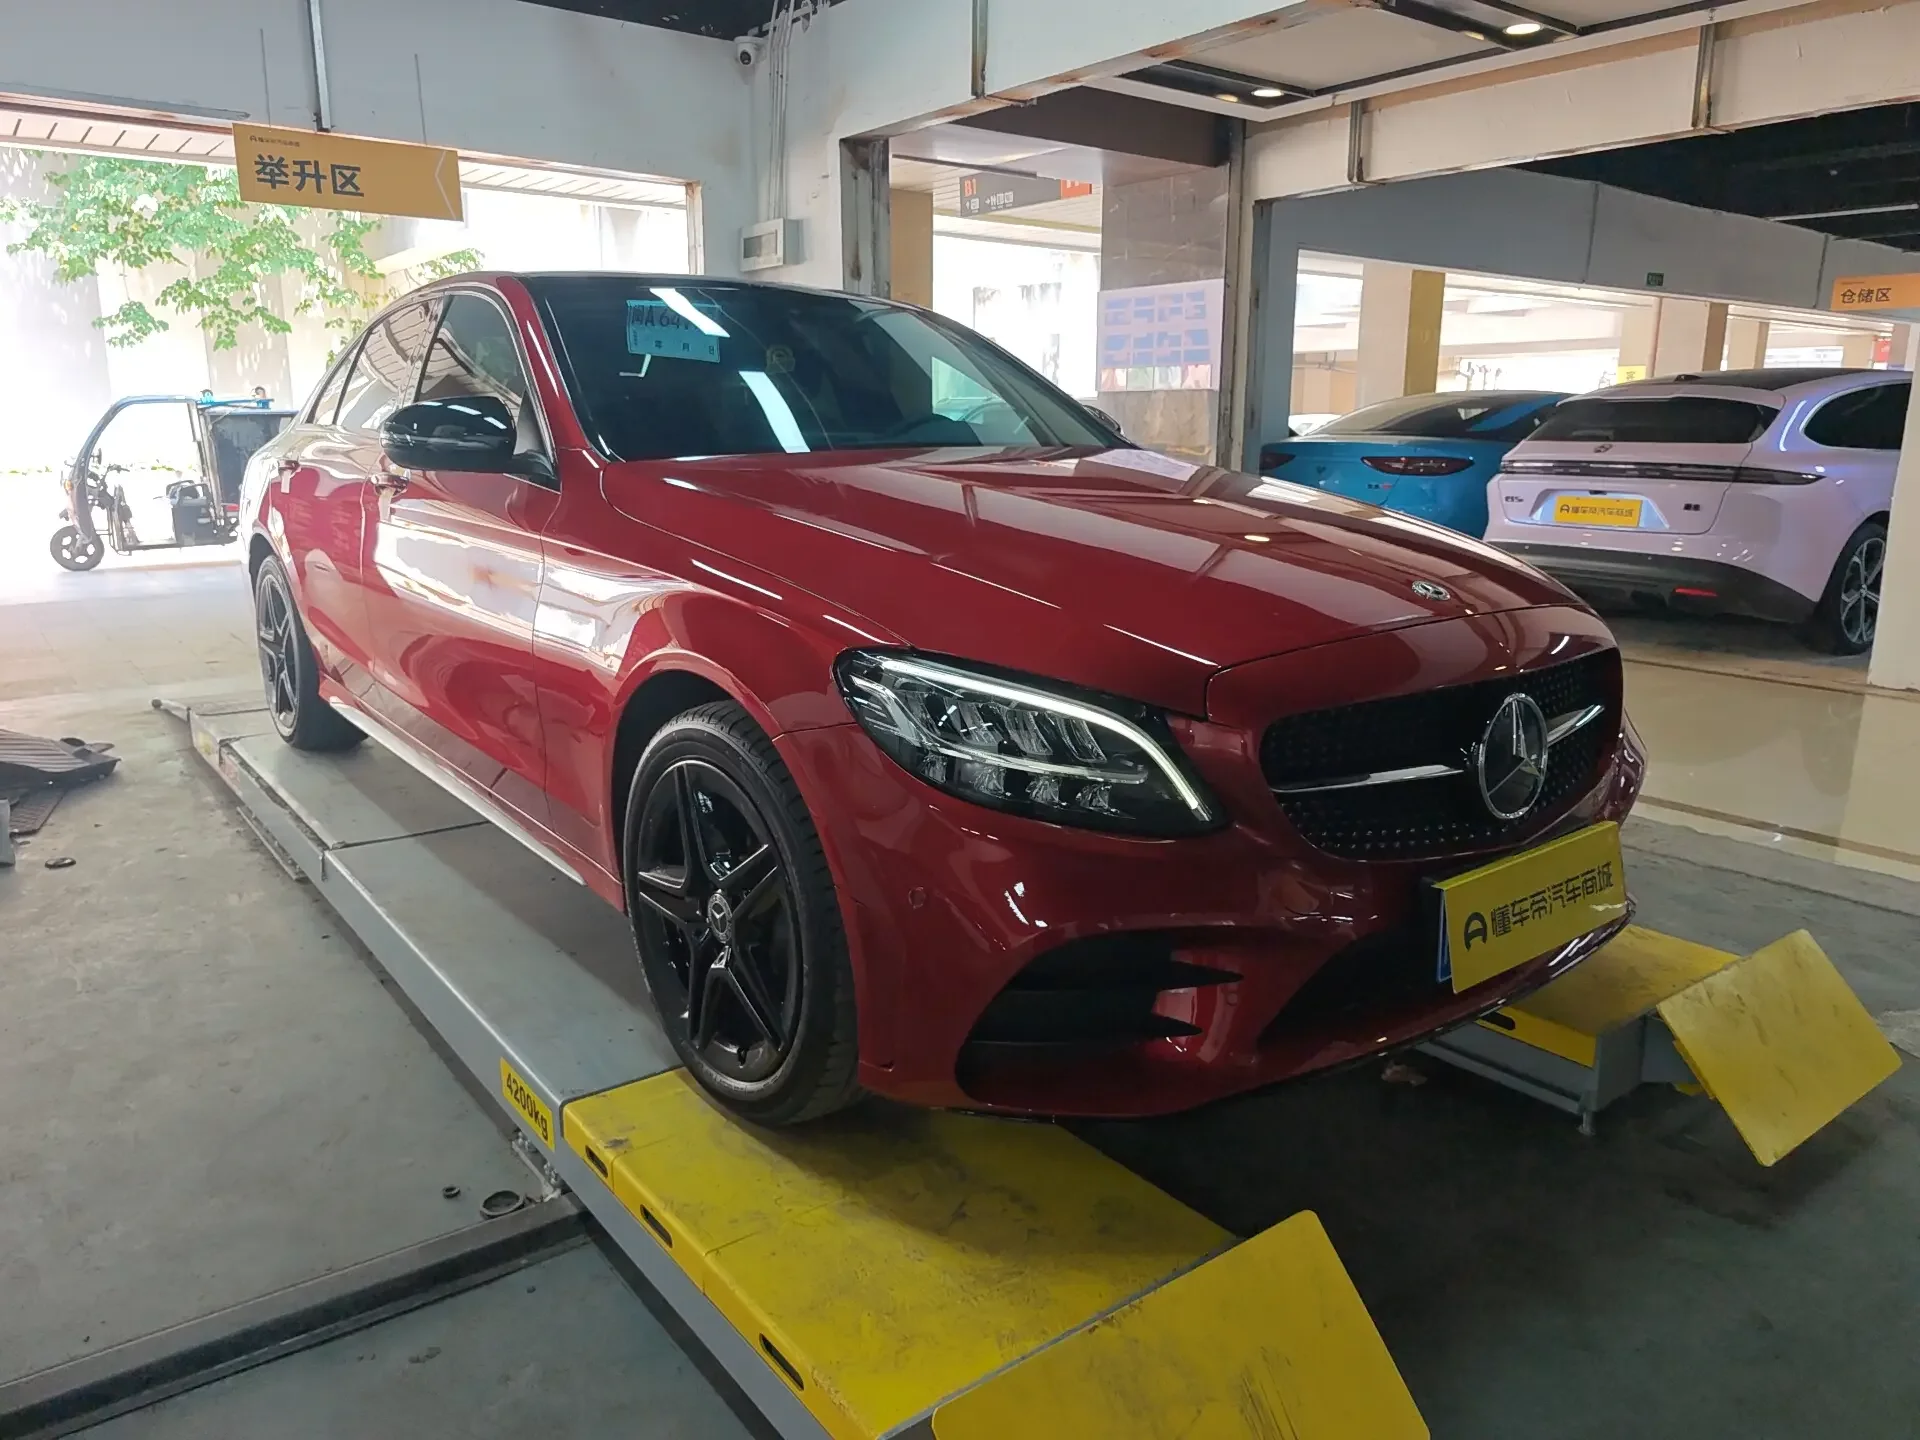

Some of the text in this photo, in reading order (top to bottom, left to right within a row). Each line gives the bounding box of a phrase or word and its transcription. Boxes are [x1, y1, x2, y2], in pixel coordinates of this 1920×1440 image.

[254, 154, 364, 197] 举升区
[964, 178, 977, 198] B1
[1841, 287, 1892, 304] 仓储区
[1490, 860, 1614, 938] 懂车帝汽车商城
[506, 1072, 548, 1142] 4200kg
